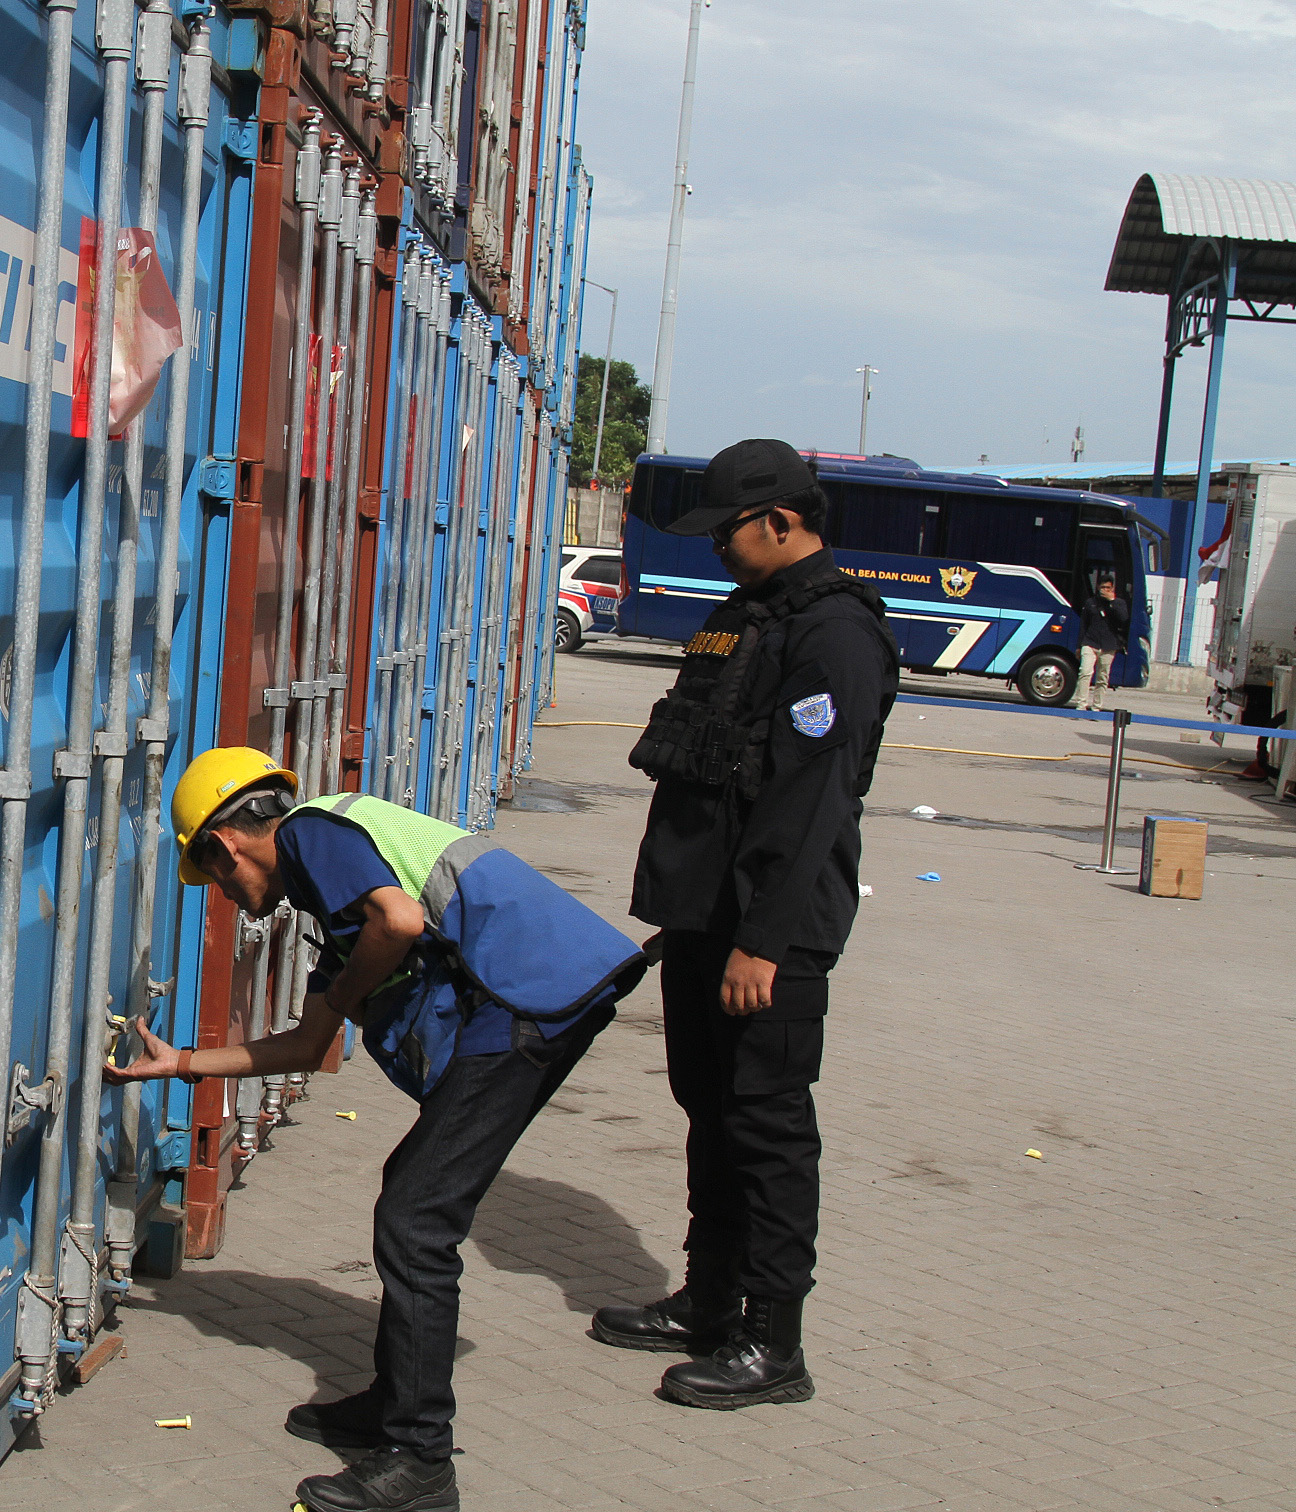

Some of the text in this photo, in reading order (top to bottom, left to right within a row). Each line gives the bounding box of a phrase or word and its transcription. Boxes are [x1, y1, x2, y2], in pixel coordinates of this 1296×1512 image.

[858, 568, 877, 579] BEA
[878, 570, 899, 581] DAN
[900, 572, 932, 584] CUKAI
